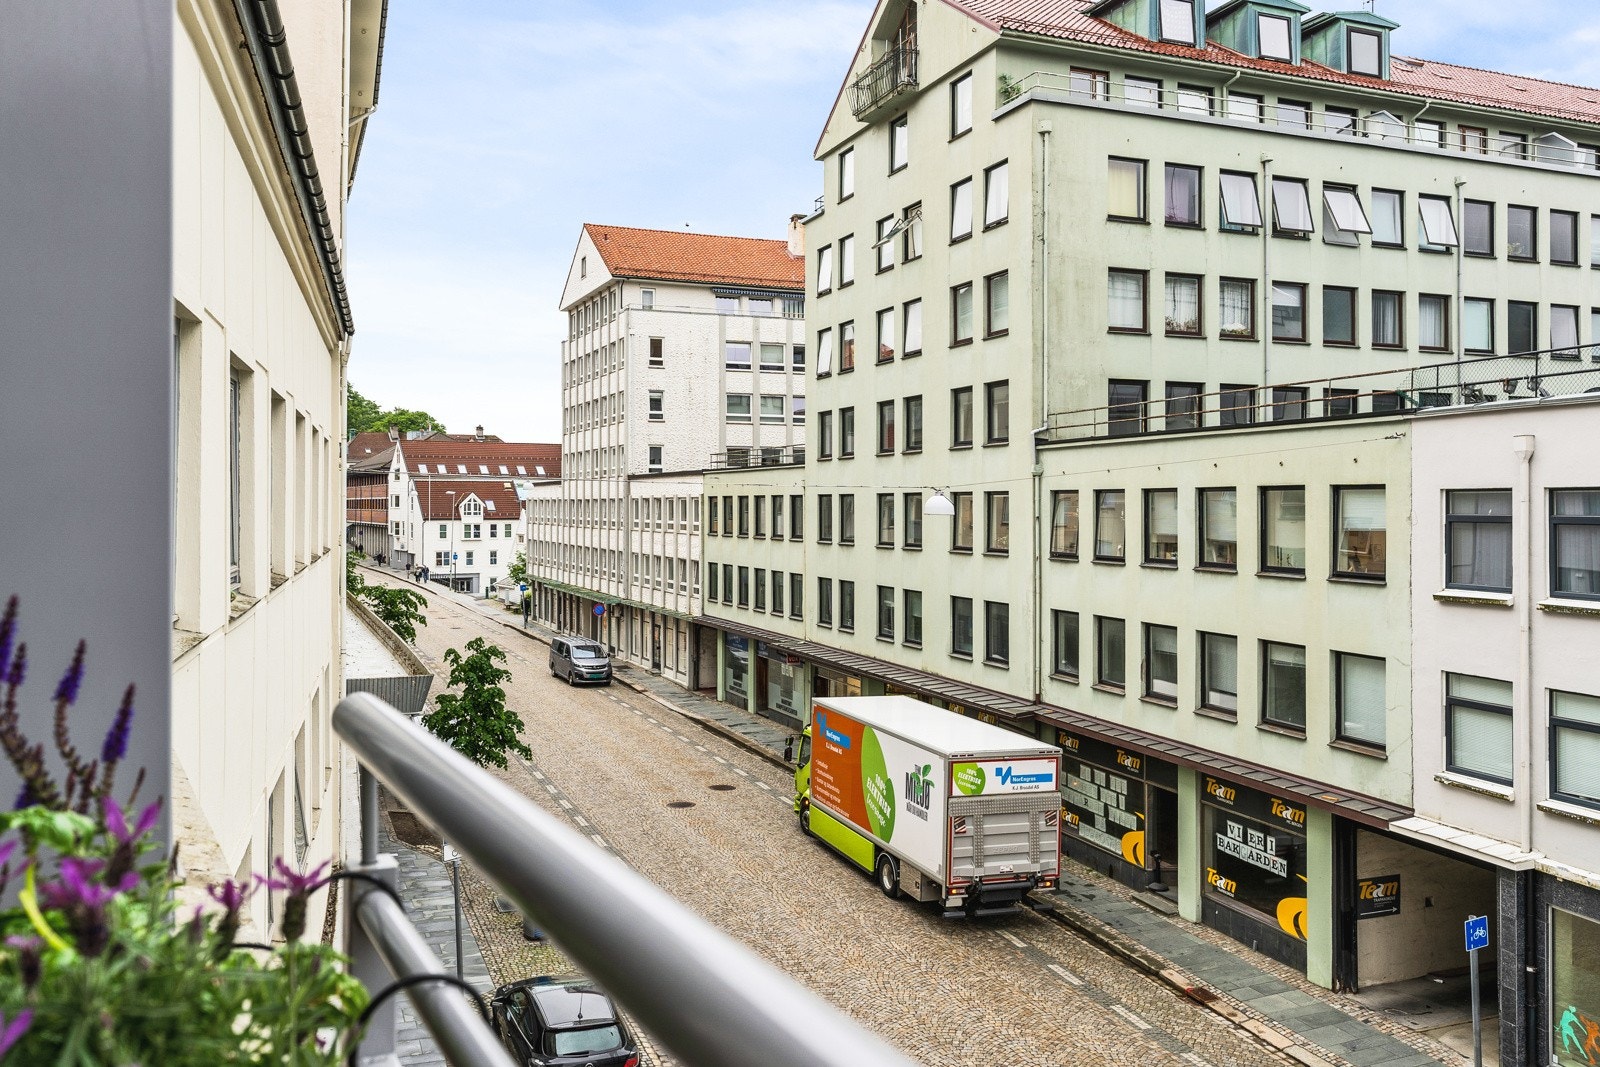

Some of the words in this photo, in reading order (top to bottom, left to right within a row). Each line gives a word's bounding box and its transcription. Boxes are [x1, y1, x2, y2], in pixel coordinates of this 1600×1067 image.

[1058, 731, 1079, 749] Team
[1116, 749, 1141, 769] Team
[967, 768, 977, 777] 100%
[866, 776, 892, 819] ELEKTRISK
[1206, 777, 1236, 801] Team
[1271, 797, 1305, 824] Team
[1228, 824, 1242, 839] VI
[1248, 832, 1264, 847] ER
[1206, 867, 1237, 894] Team
[1358, 881, 1398, 900] Team
